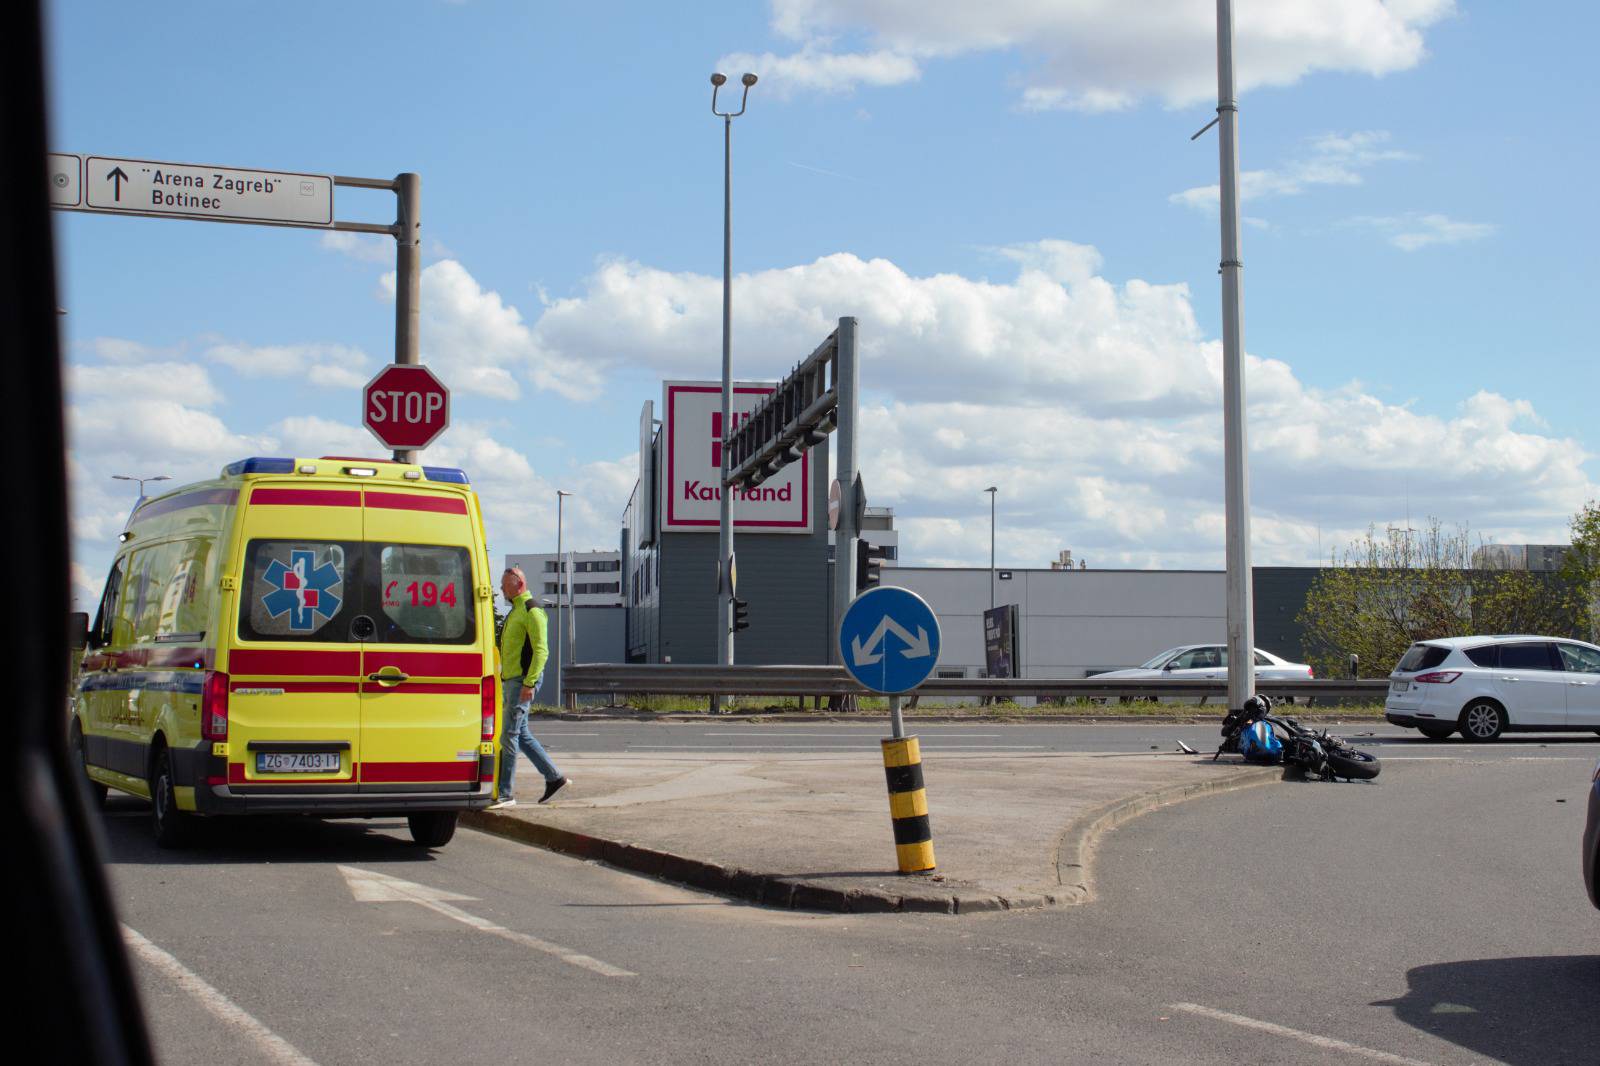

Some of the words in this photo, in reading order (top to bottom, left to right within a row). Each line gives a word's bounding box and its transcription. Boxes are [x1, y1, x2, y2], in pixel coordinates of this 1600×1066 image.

[152, 189, 221, 209] Botinec
[370, 390, 443, 423] STOP
[406, 581, 457, 608] 194
[266, 754, 282, 768] ZG
